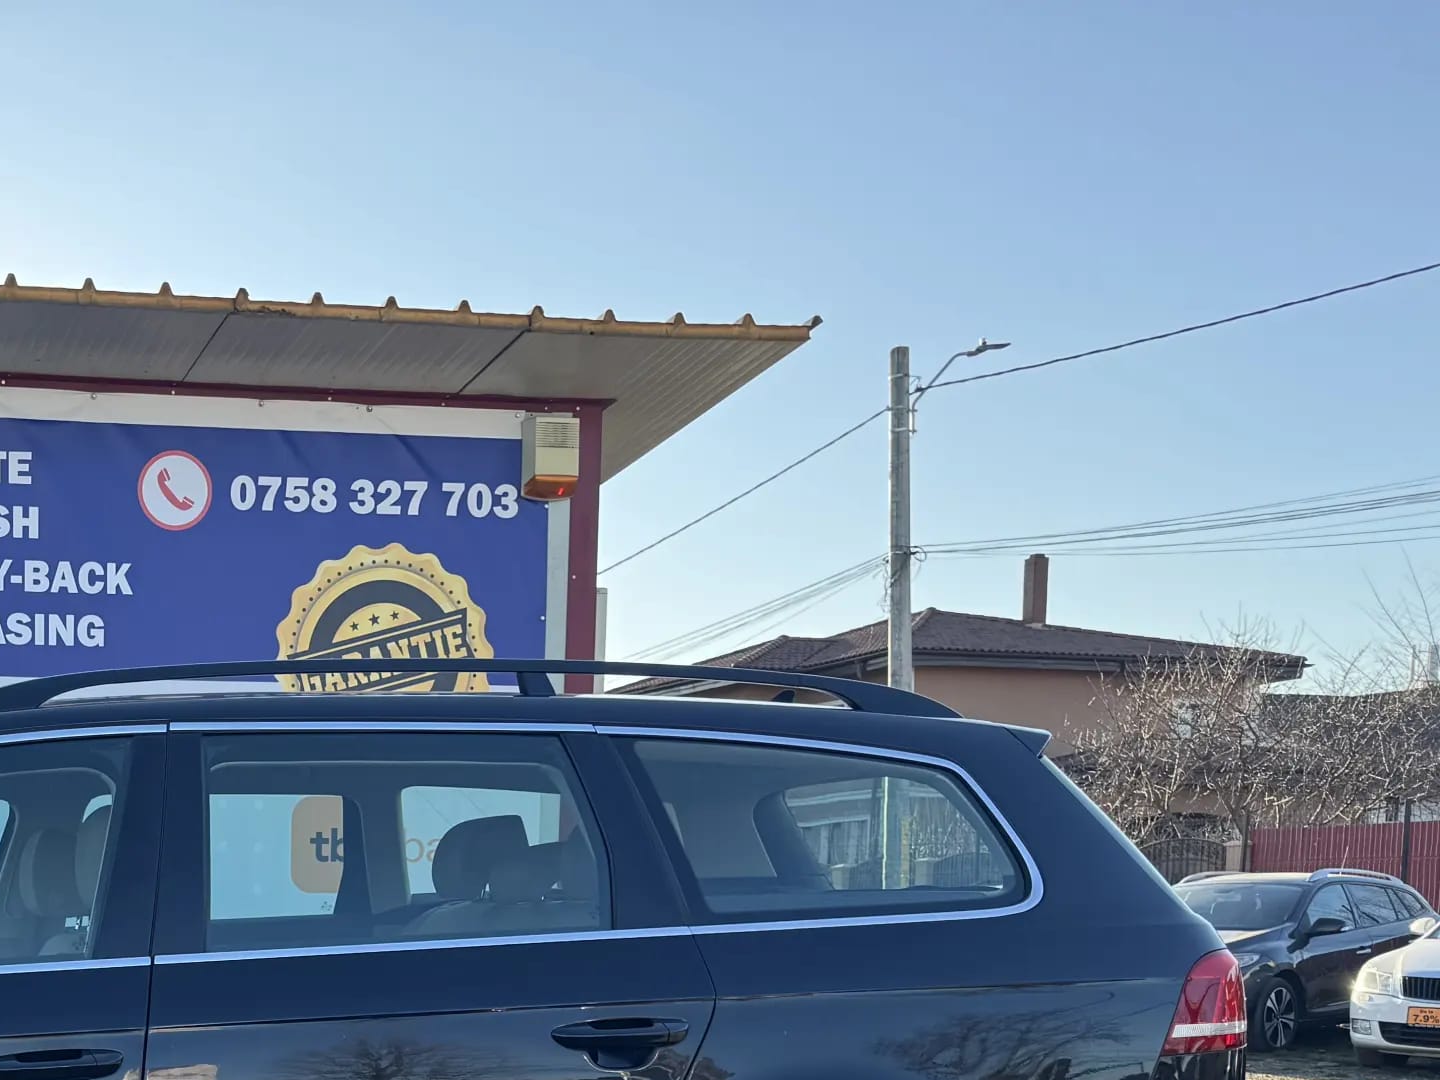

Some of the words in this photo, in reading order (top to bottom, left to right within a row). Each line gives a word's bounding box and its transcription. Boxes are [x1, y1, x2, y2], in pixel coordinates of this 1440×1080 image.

[230, 475, 337, 513] 0758
[349, 478, 426, 516] 327
[442, 482, 519, 519] 703
